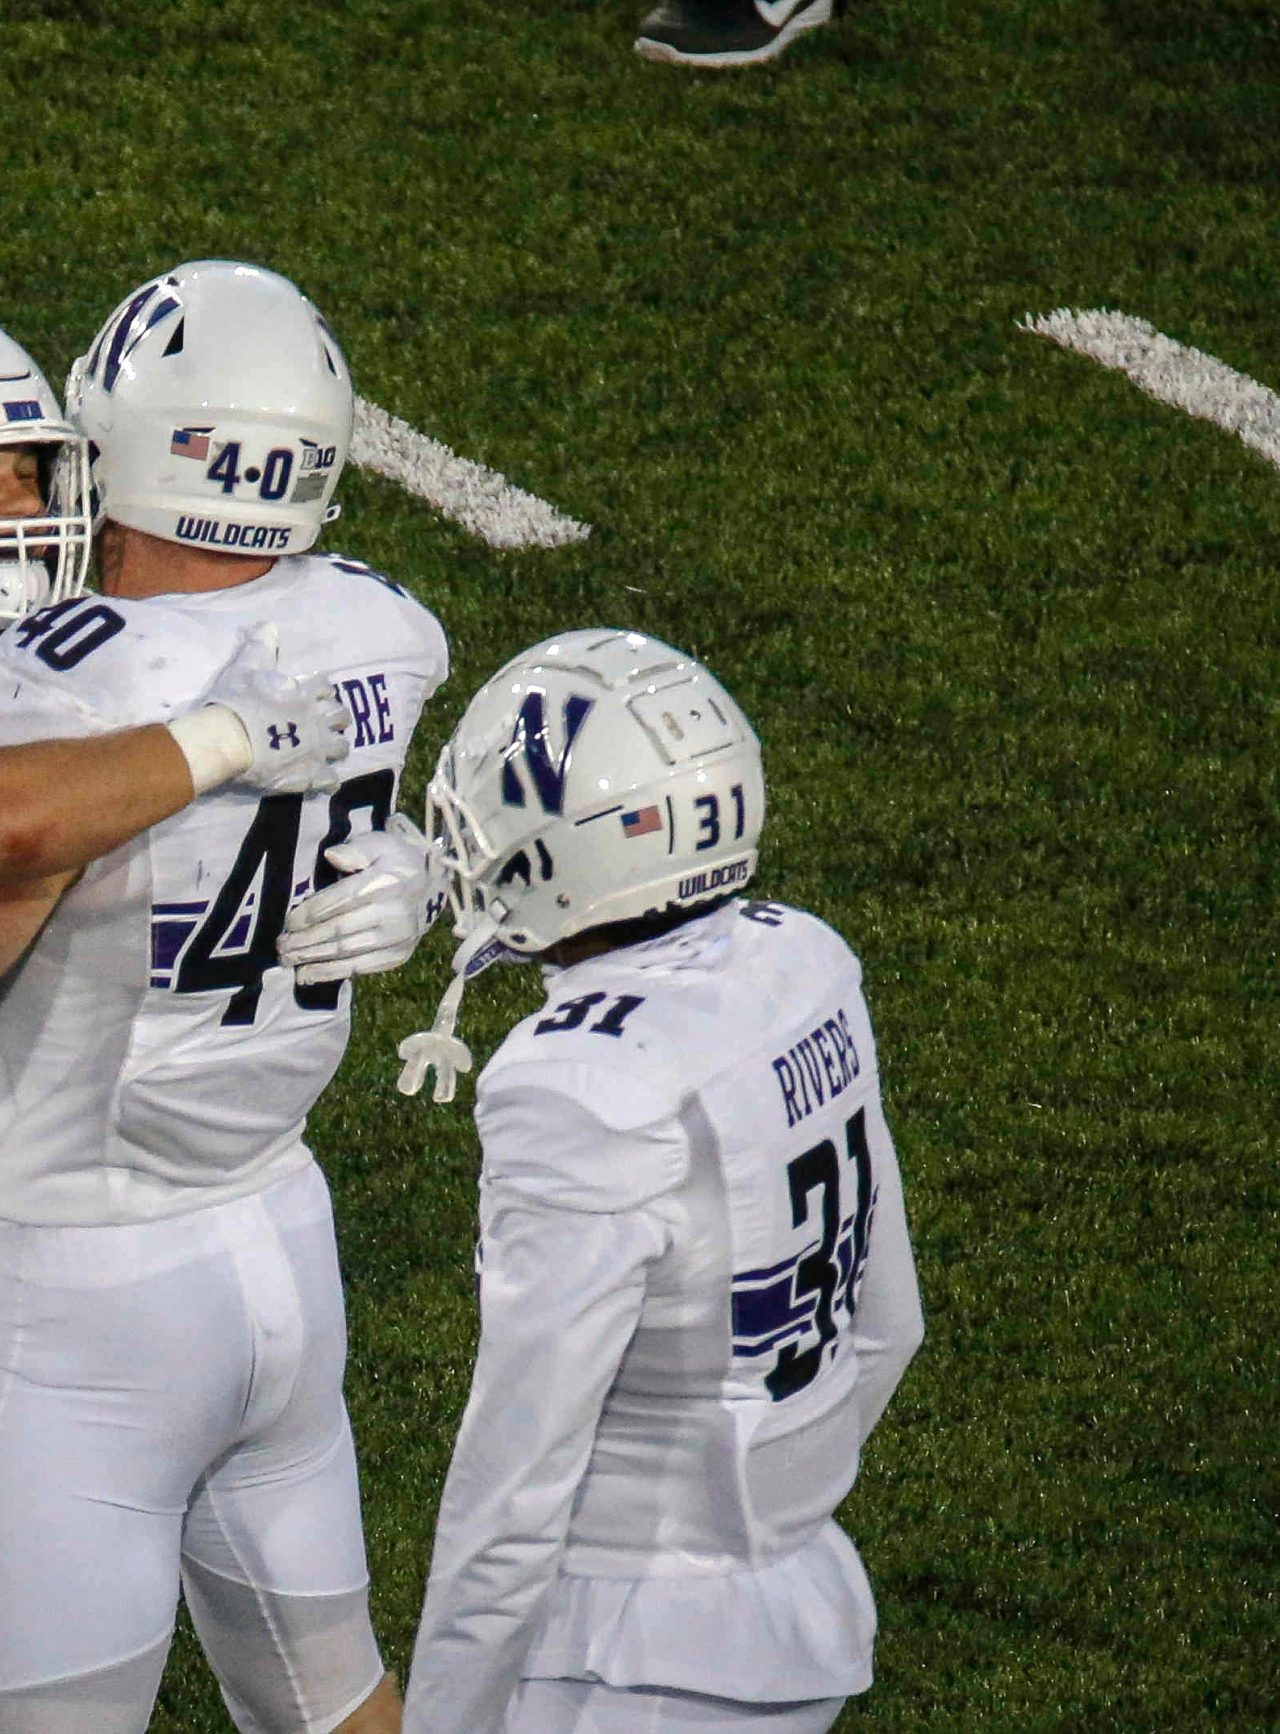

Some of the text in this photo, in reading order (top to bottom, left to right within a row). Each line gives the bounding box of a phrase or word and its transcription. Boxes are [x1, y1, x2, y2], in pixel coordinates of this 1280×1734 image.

[175, 516, 292, 549] WILDCATS
[16, 596, 126, 672] 40
[334, 674, 395, 748] RE
[694, 783, 745, 850] 31
[679, 859, 749, 899] WILDCATS
[533, 991, 646, 1039] 31
[771, 1008, 860, 1128] RIVERS
[765, 1104, 873, 1402] 31
